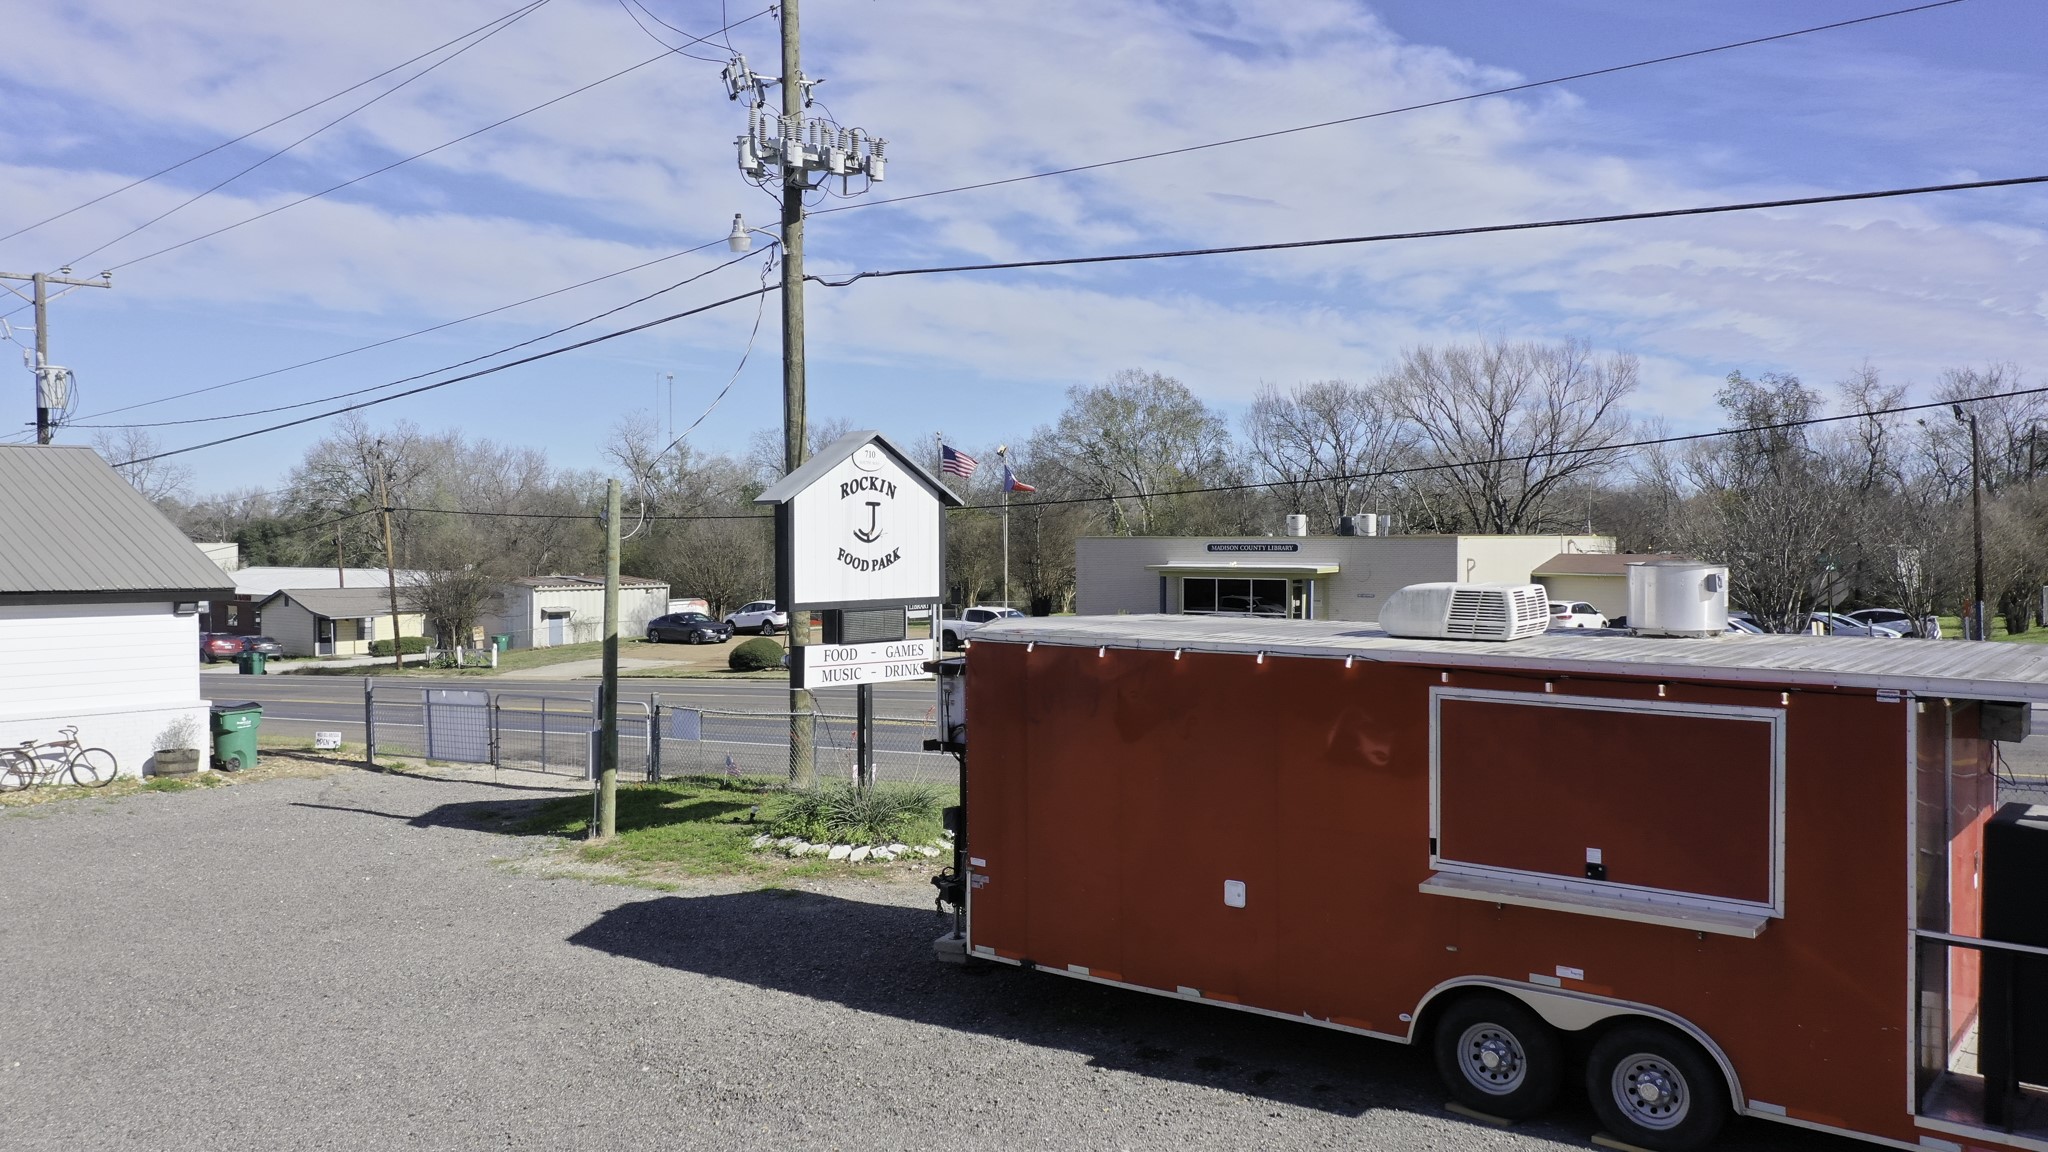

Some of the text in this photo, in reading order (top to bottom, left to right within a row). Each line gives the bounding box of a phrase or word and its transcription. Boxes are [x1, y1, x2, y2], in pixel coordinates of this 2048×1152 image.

[865, 450, 876, 459] 710
[840, 476, 897, 500] ROCKIN
[856, 501, 882, 541] J
[837, 546, 901, 572] FOOD PARK
[823, 648, 858, 662] FOOD
[885, 643, 924, 658] GAMES
[821, 667, 862, 683] MUSIC
[885, 662, 926, 678] DRINKS
